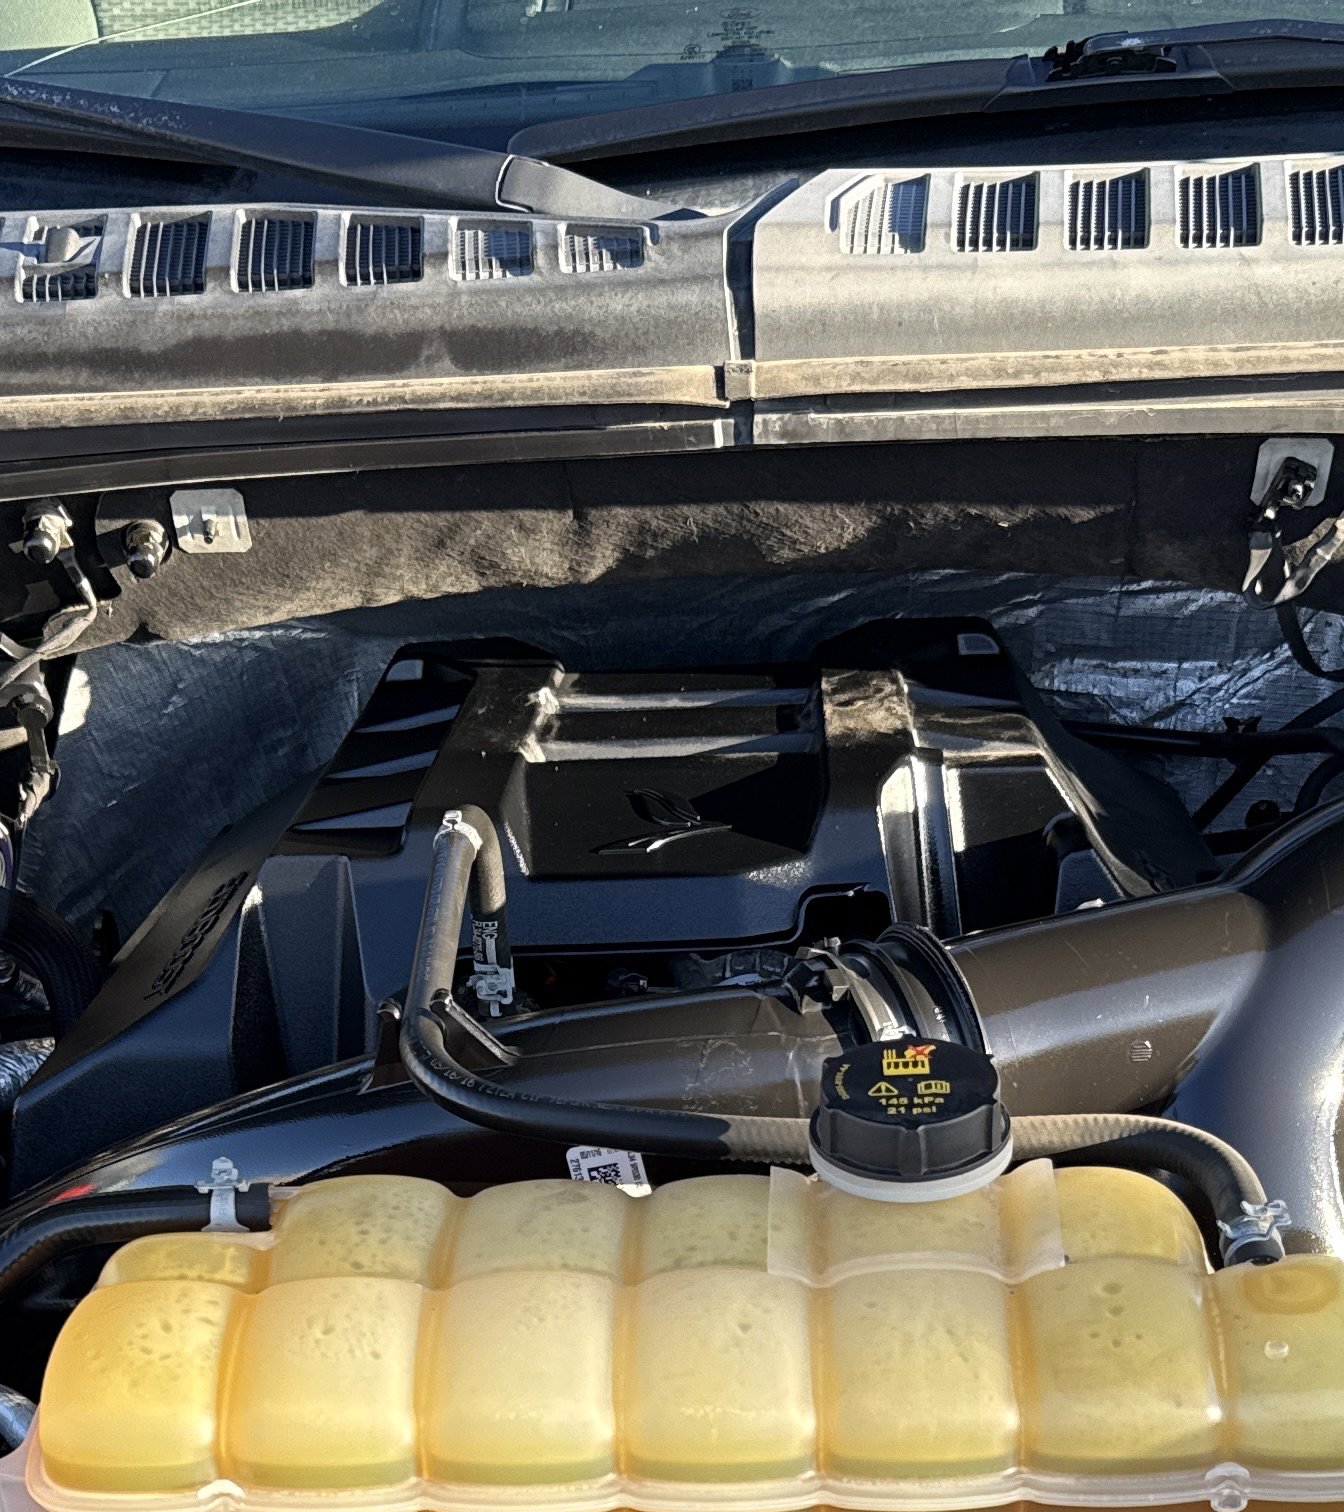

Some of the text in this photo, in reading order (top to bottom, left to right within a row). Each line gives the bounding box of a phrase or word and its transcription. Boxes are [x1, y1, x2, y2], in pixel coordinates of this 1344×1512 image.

[481, 920, 499, 940] ENG
[913, 1096, 945, 1105] kPa
[887, 1105, 937, 1115] 21 psi
